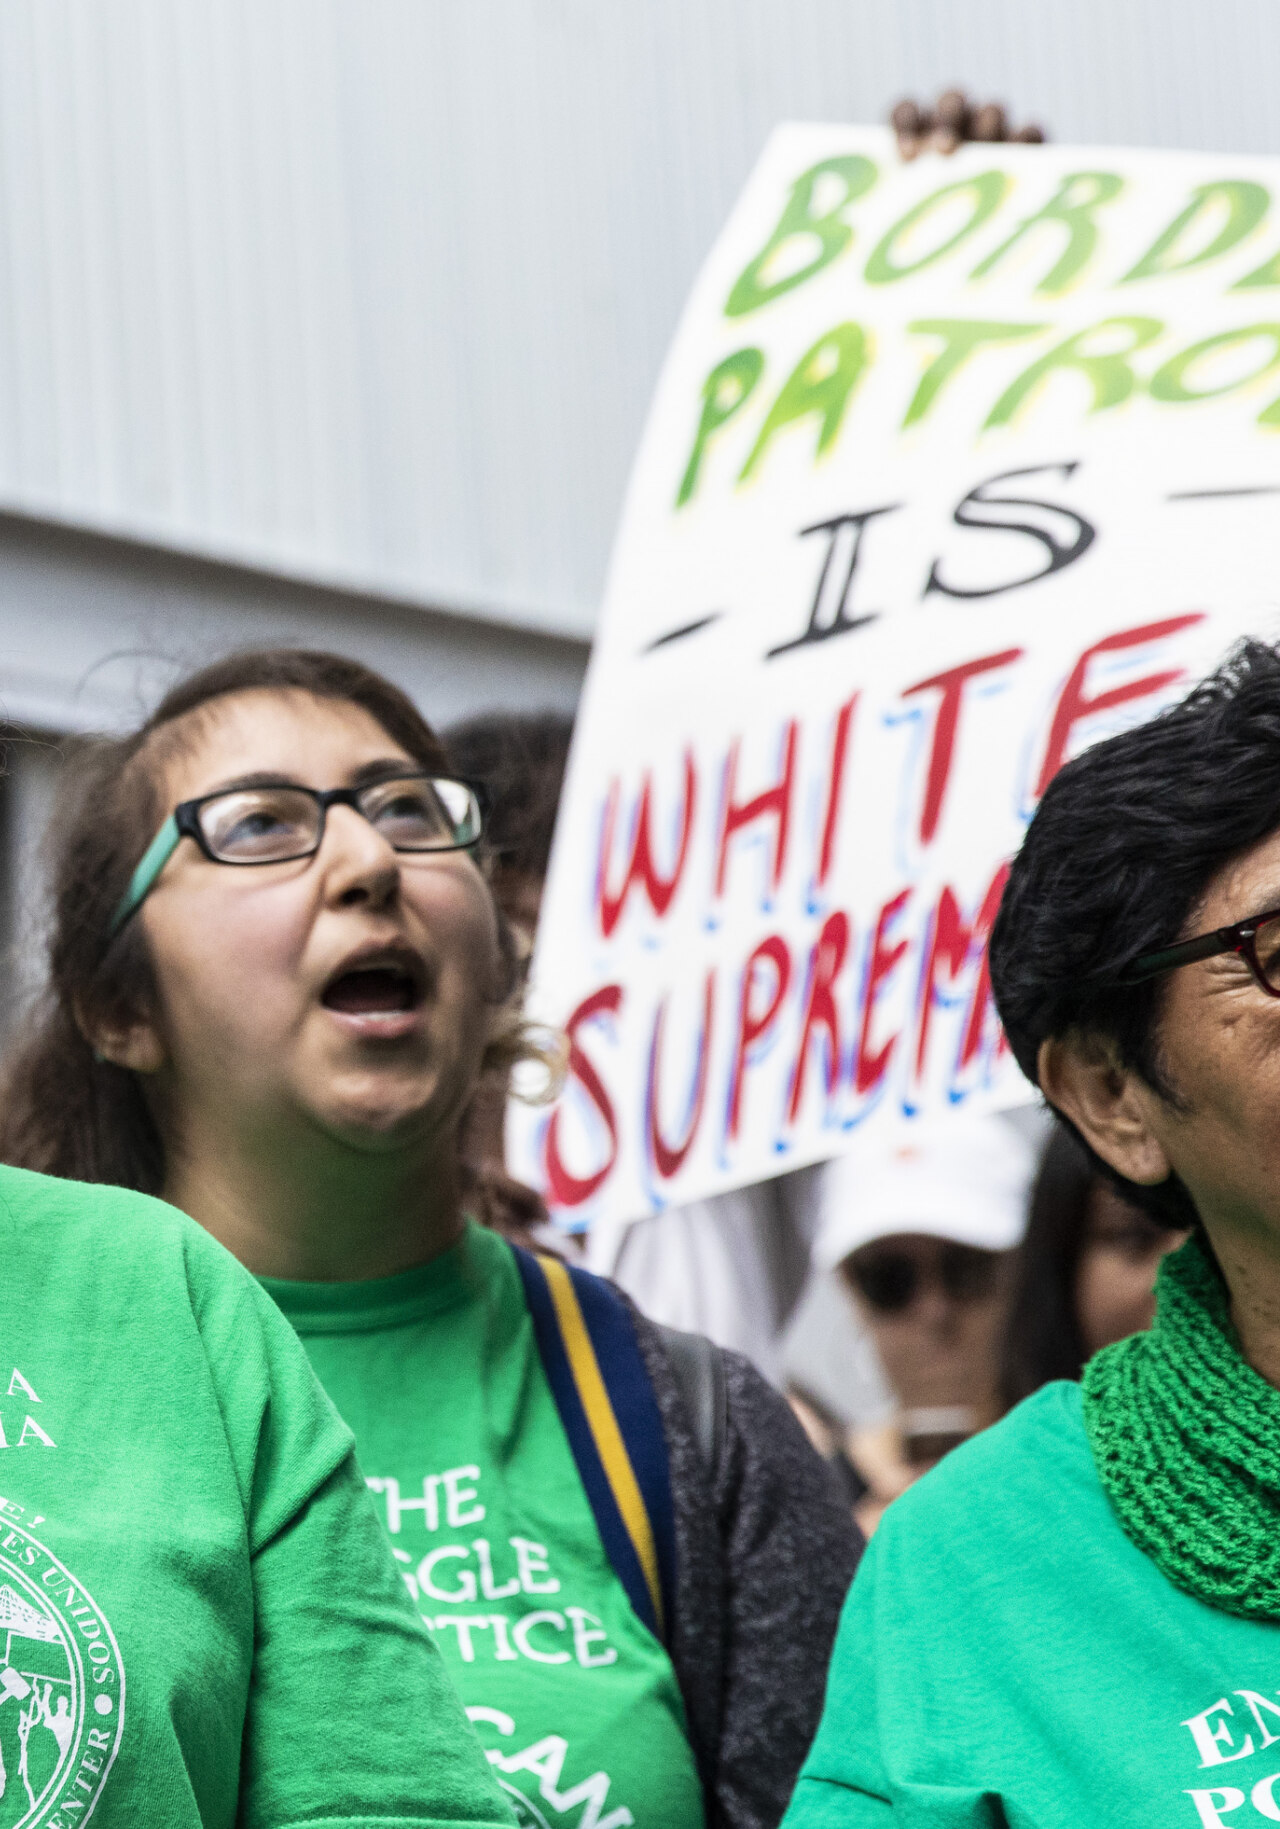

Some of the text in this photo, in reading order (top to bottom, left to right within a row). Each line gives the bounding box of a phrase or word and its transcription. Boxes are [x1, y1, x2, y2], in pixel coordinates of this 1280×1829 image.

[675, 315, 1280, 509] PATRO
[766, 461, 1096, 659] IS
[597, 612, 1206, 939] WHITE
[542, 861, 1013, 1206] SUPREM
[41, 1566, 115, 1684] UNIDOS
[422, 1607, 618, 1668] TICE
